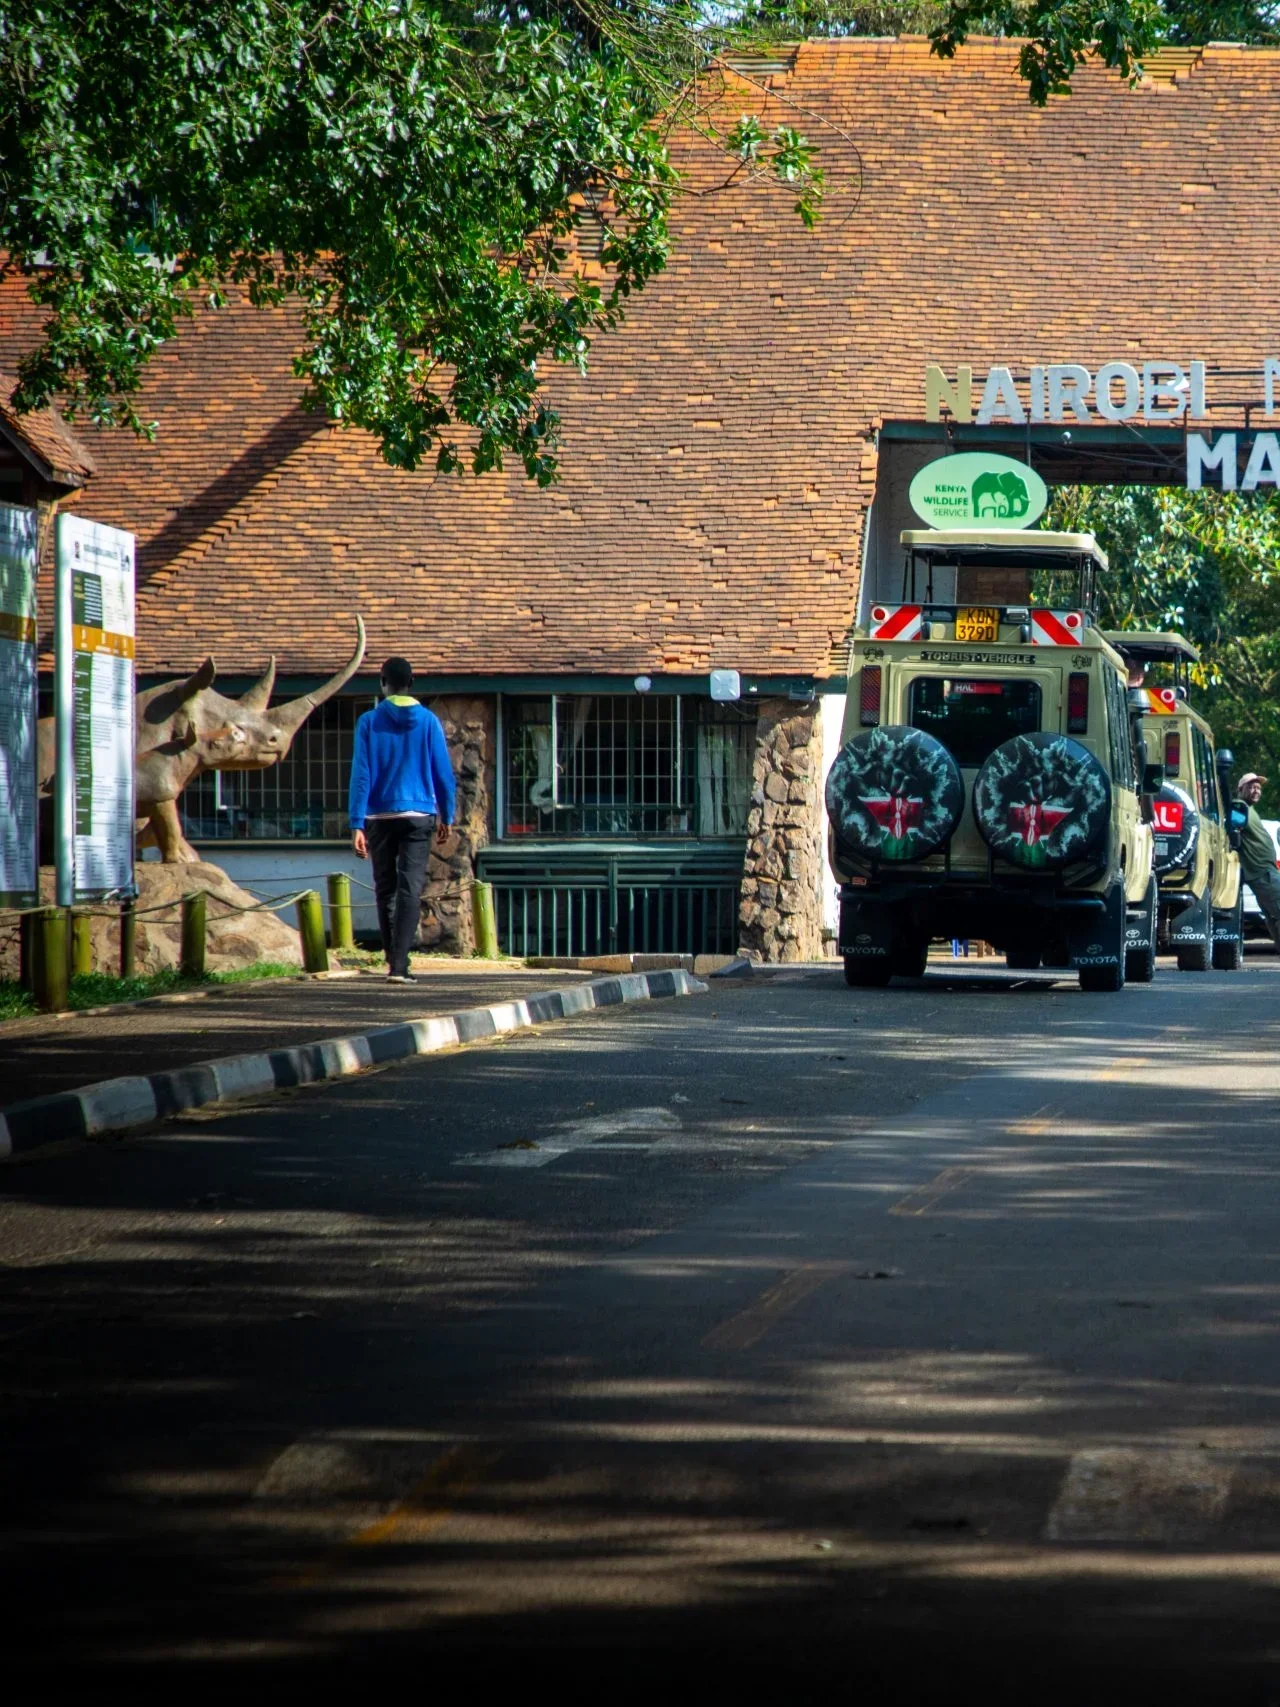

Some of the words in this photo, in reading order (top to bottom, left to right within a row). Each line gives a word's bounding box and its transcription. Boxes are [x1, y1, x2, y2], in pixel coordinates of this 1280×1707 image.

[926, 361, 1205, 424] NAIROBI
[935, 484, 967, 493] KENYA
[923, 496, 969, 506] WILDLIFE
[933, 508, 969, 517] SERVICE
[966, 607, 995, 624] KDN
[980, 653, 1032, 664] VEHICLE
[1127, 939, 1150, 947] OTA
[840, 946, 886, 955] TOYOTA
[1072, 955, 1119, 965] TOYOTA
